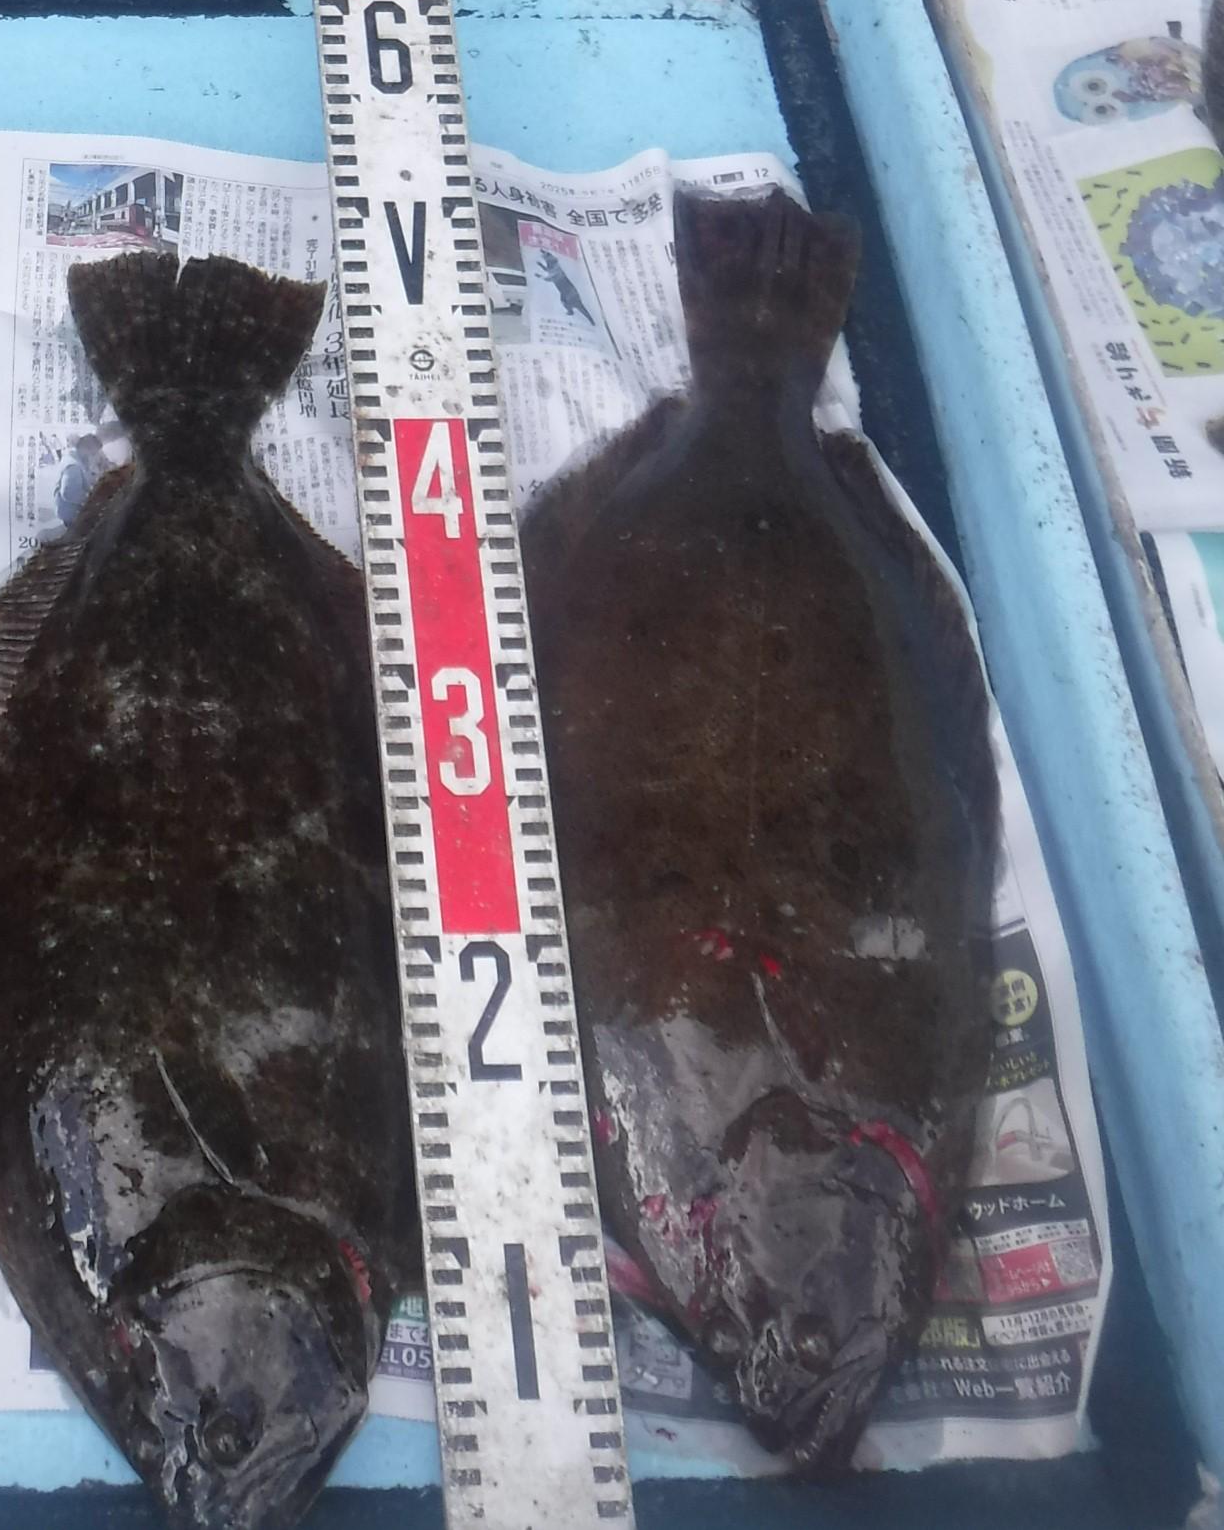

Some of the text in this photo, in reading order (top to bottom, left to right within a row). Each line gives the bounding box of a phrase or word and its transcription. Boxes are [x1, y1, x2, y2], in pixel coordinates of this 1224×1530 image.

[363, 0, 413, 95] 6
[754, 167, 769, 179] 12
[383, 201, 426, 305] V
[410, 421, 464, 539] 4
[431, 666, 493, 797] 3
[459, 940, 523, 1082] 2
[401, 1346, 433, 1369] 05
[504, 1243, 540, 1399] 1
